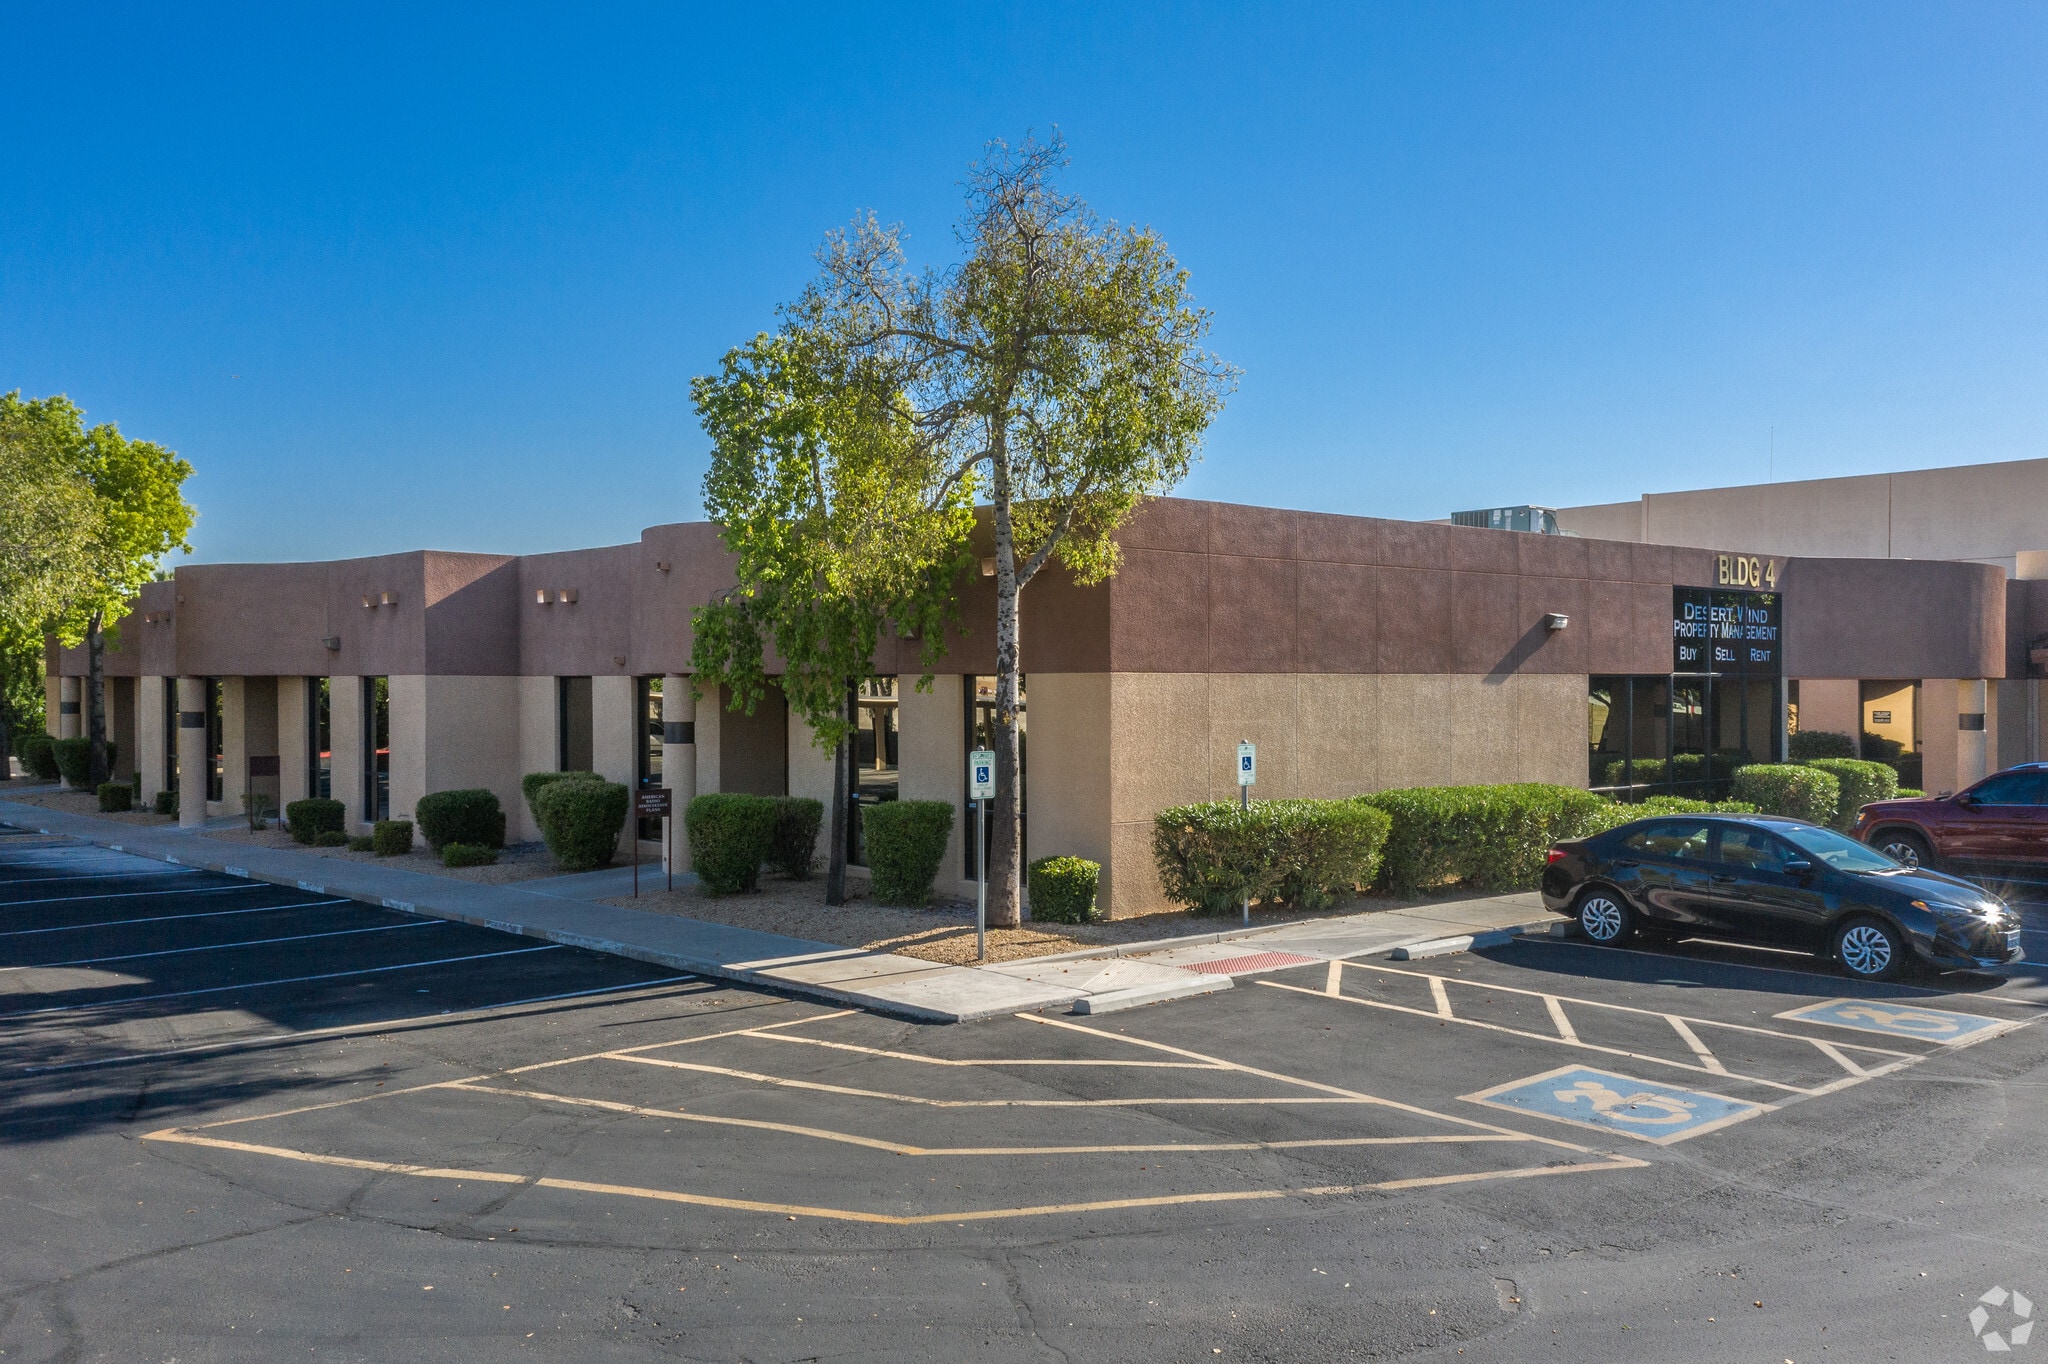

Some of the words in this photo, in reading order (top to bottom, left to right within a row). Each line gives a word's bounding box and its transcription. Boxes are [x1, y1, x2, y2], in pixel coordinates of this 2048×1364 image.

[1718, 554, 1760, 588] BLDG
[1765, 559, 1776, 588] 4
[1680, 645, 1697, 660] BUY
[1715, 646, 1736, 661] SELL
[1750, 647, 1771, 662] RENT
